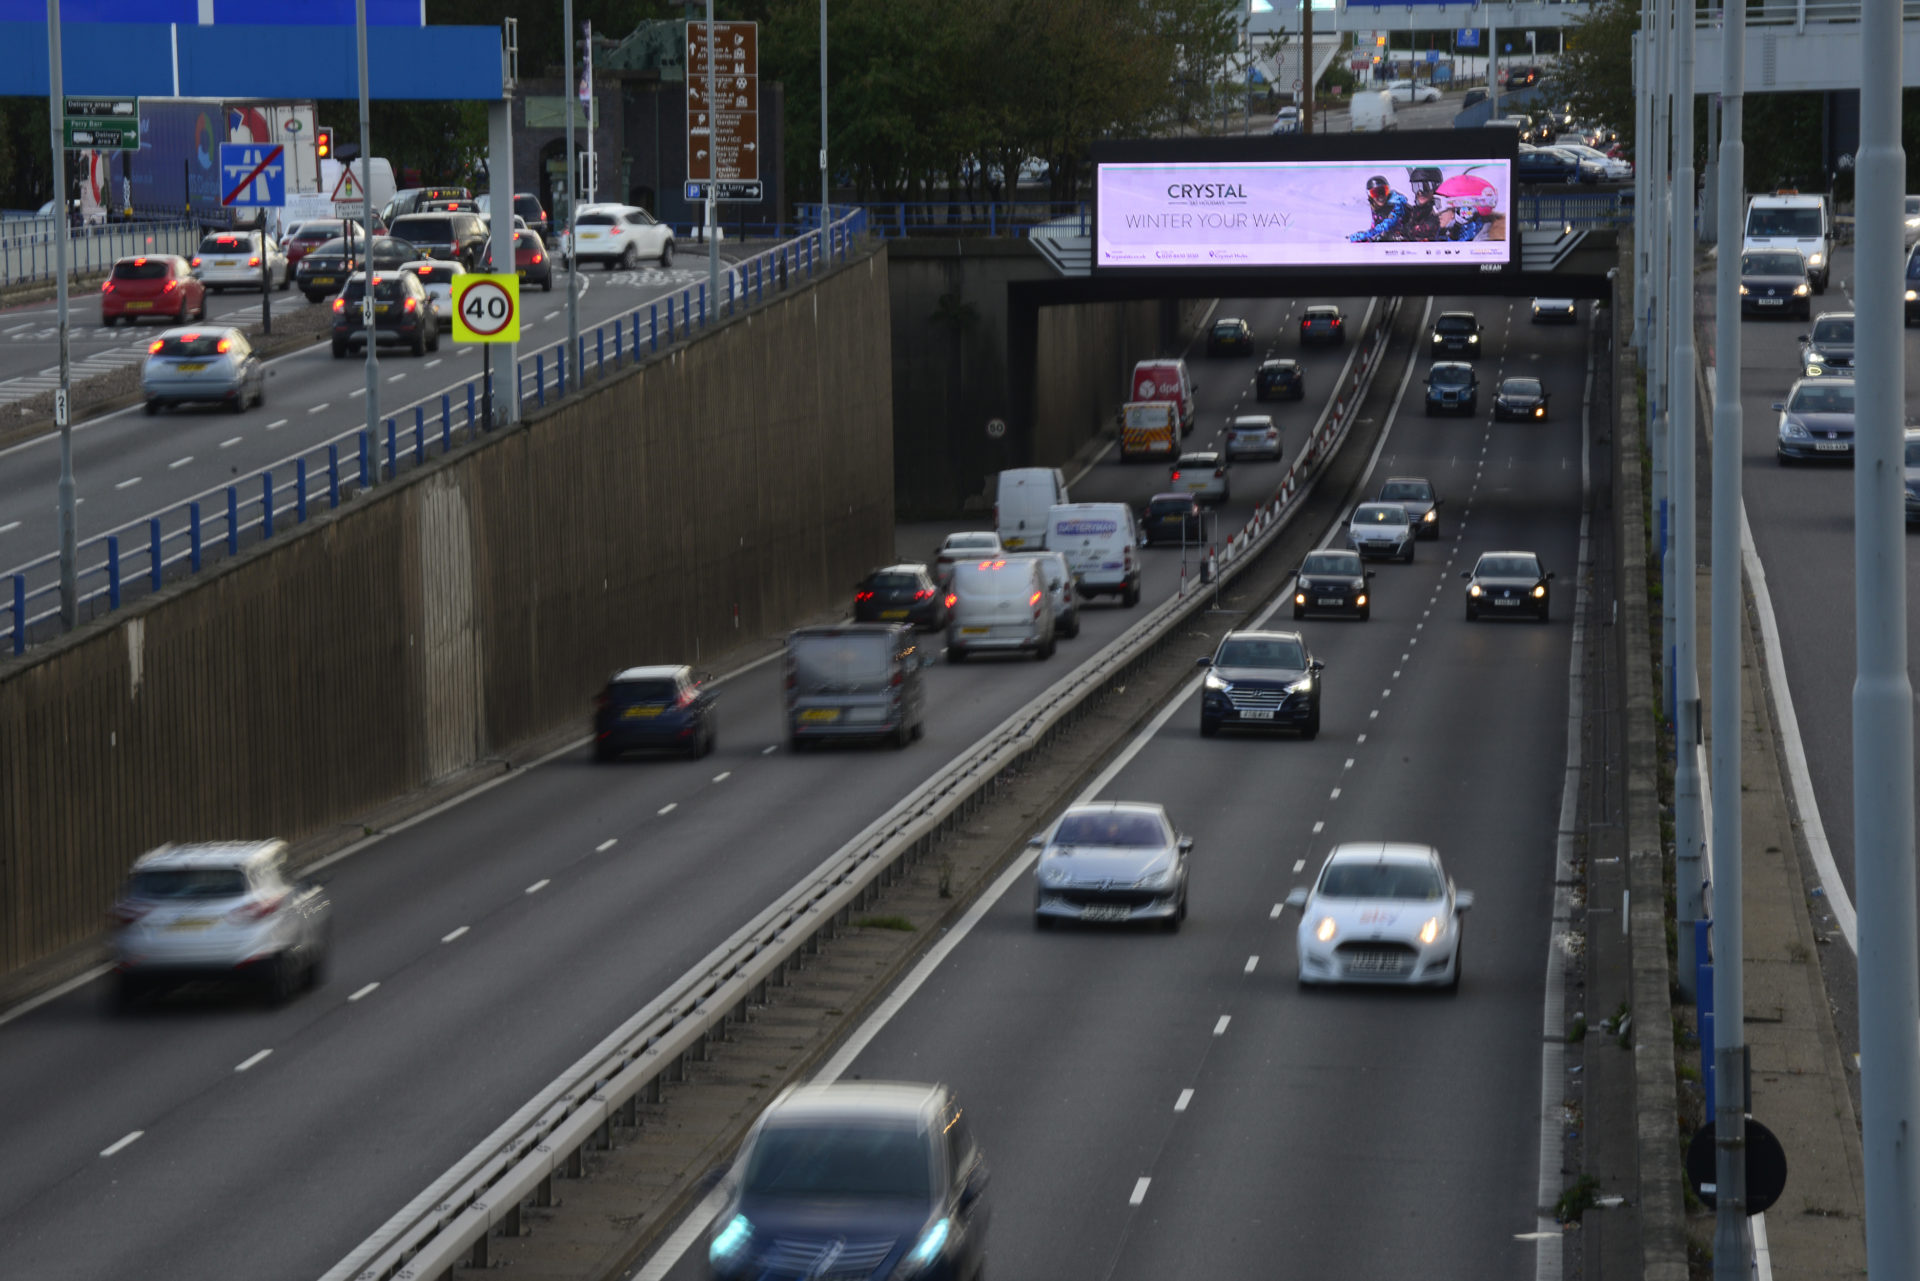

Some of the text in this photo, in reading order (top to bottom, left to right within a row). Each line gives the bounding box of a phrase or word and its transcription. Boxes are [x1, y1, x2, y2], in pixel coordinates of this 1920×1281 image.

[728, 184, 745, 192] Lorry
[1168, 184, 1247, 198] CRYSTAL
[1125, 213, 1291, 228] WINTER YOUR WAY
[466, 296, 506, 319] 40
[1159, 382, 1179, 395] dpd
[58, 395, 65, 419] 21
